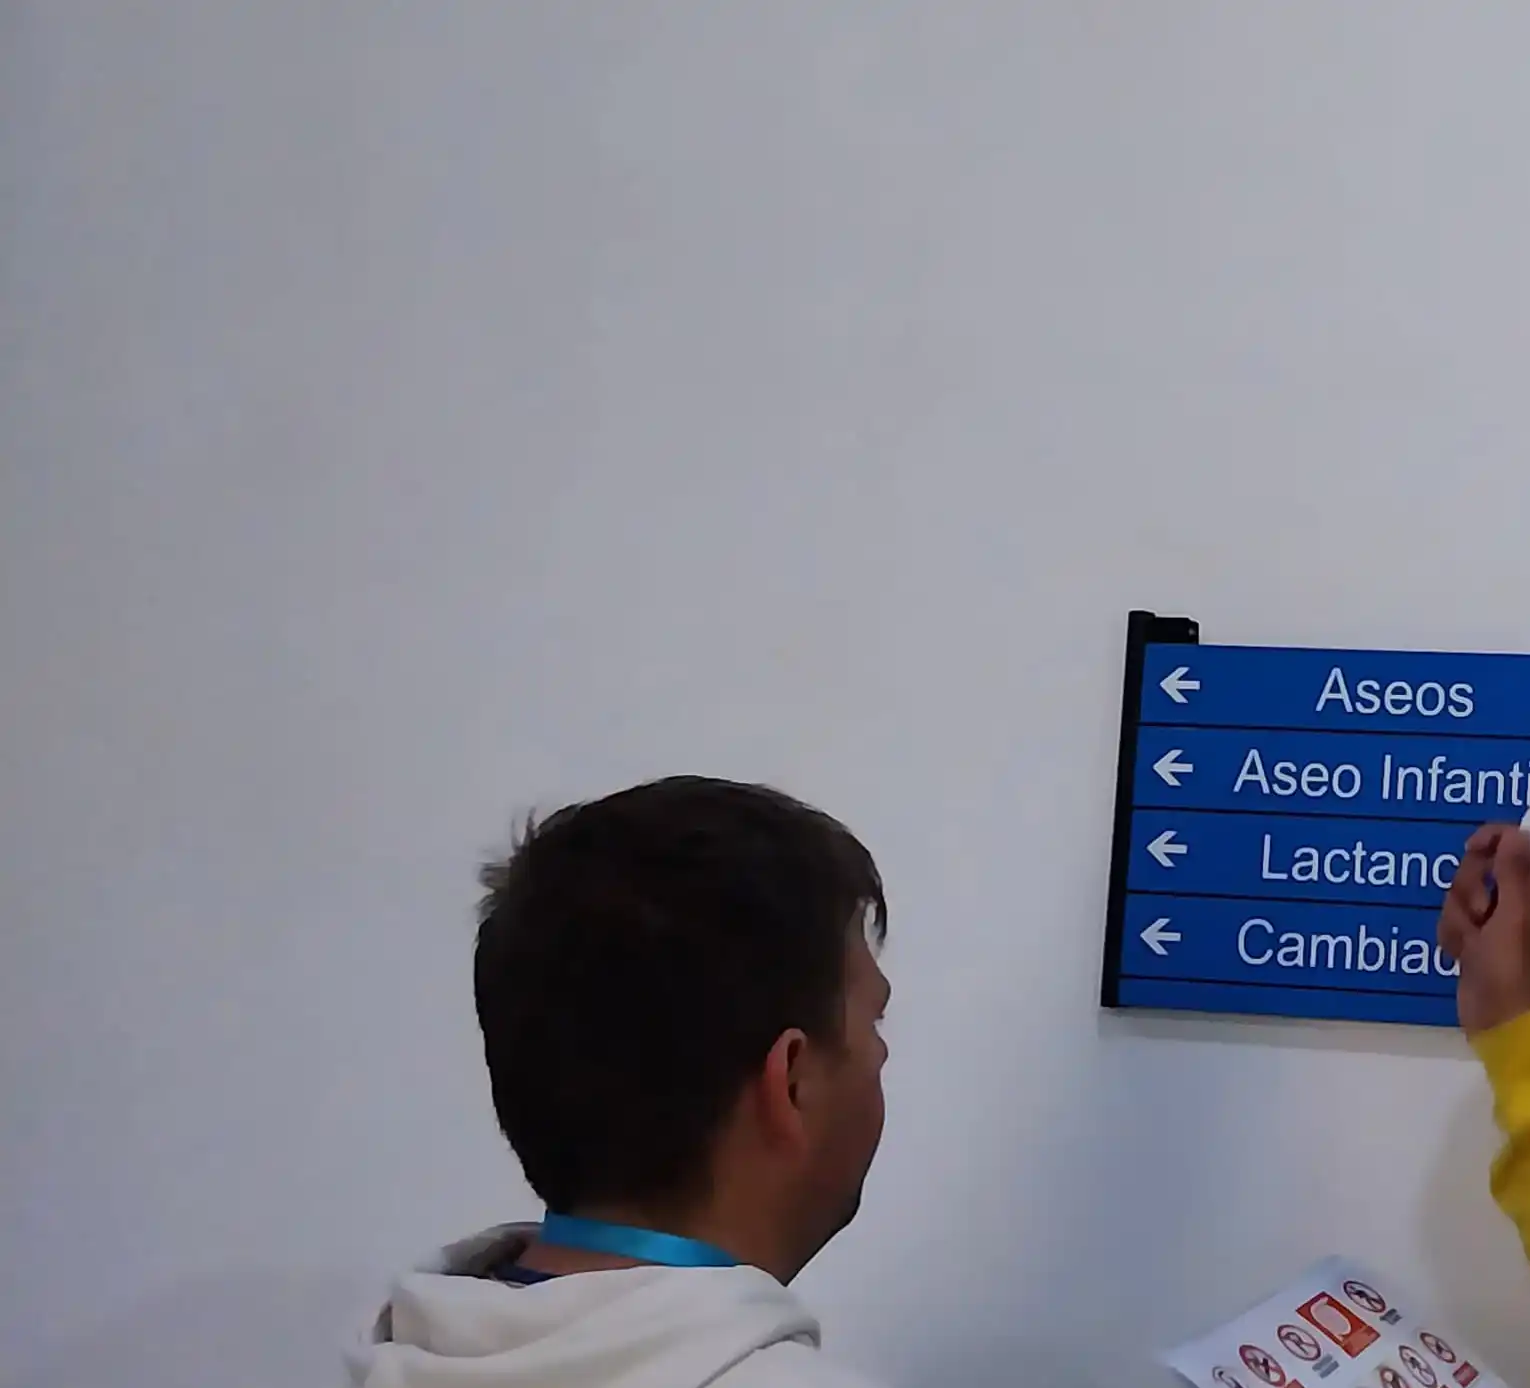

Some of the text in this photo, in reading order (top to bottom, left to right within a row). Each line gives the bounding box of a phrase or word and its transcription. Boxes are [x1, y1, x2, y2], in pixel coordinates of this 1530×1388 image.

[1315, 667, 1474, 718] Aseos
[1233, 748, 1362, 799] Aseo
[1261, 834, 1460, 889] Lactanc
[1237, 918, 1460, 976] Cambia
